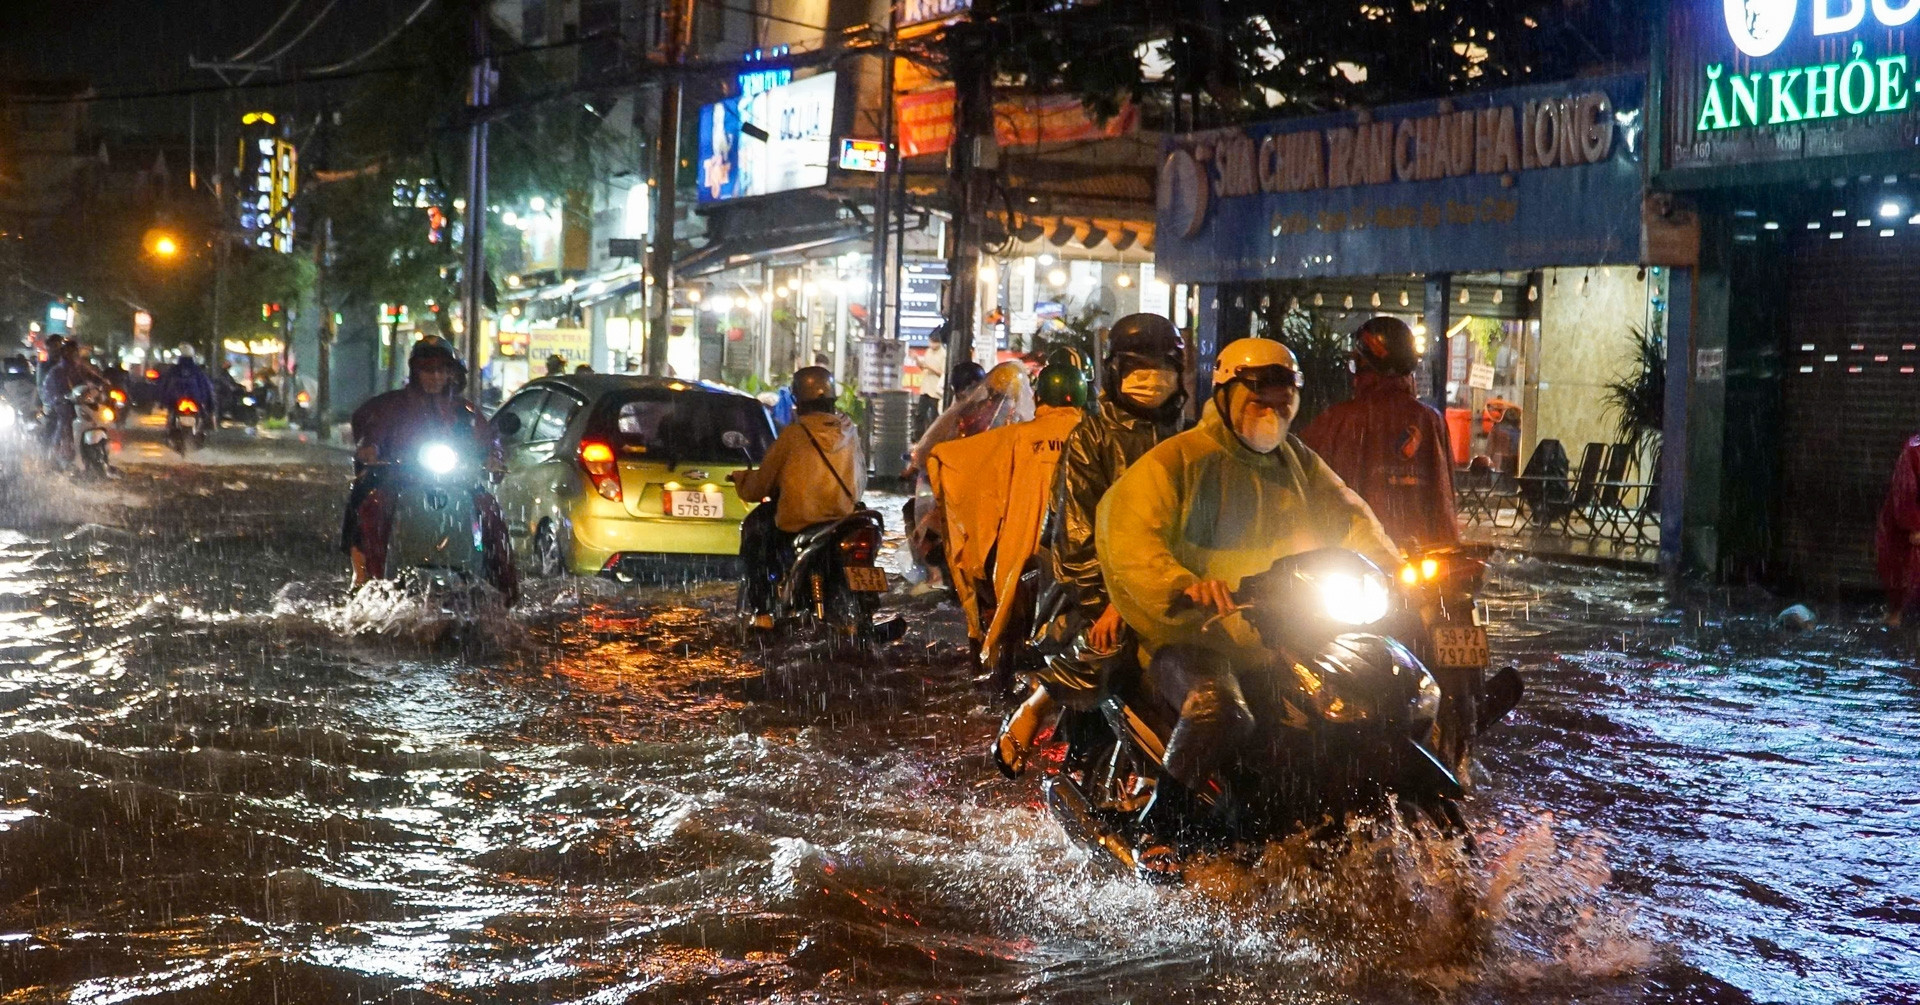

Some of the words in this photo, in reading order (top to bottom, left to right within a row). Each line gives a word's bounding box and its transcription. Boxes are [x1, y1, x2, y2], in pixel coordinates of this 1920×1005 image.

[1697, 62, 1762, 131] ĂN
[1768, 40, 1910, 125] KHỎE
[1522, 90, 1613, 170] LONG
[678, 504, 718, 516] 578.57
[686, 492, 708, 504] 49A
